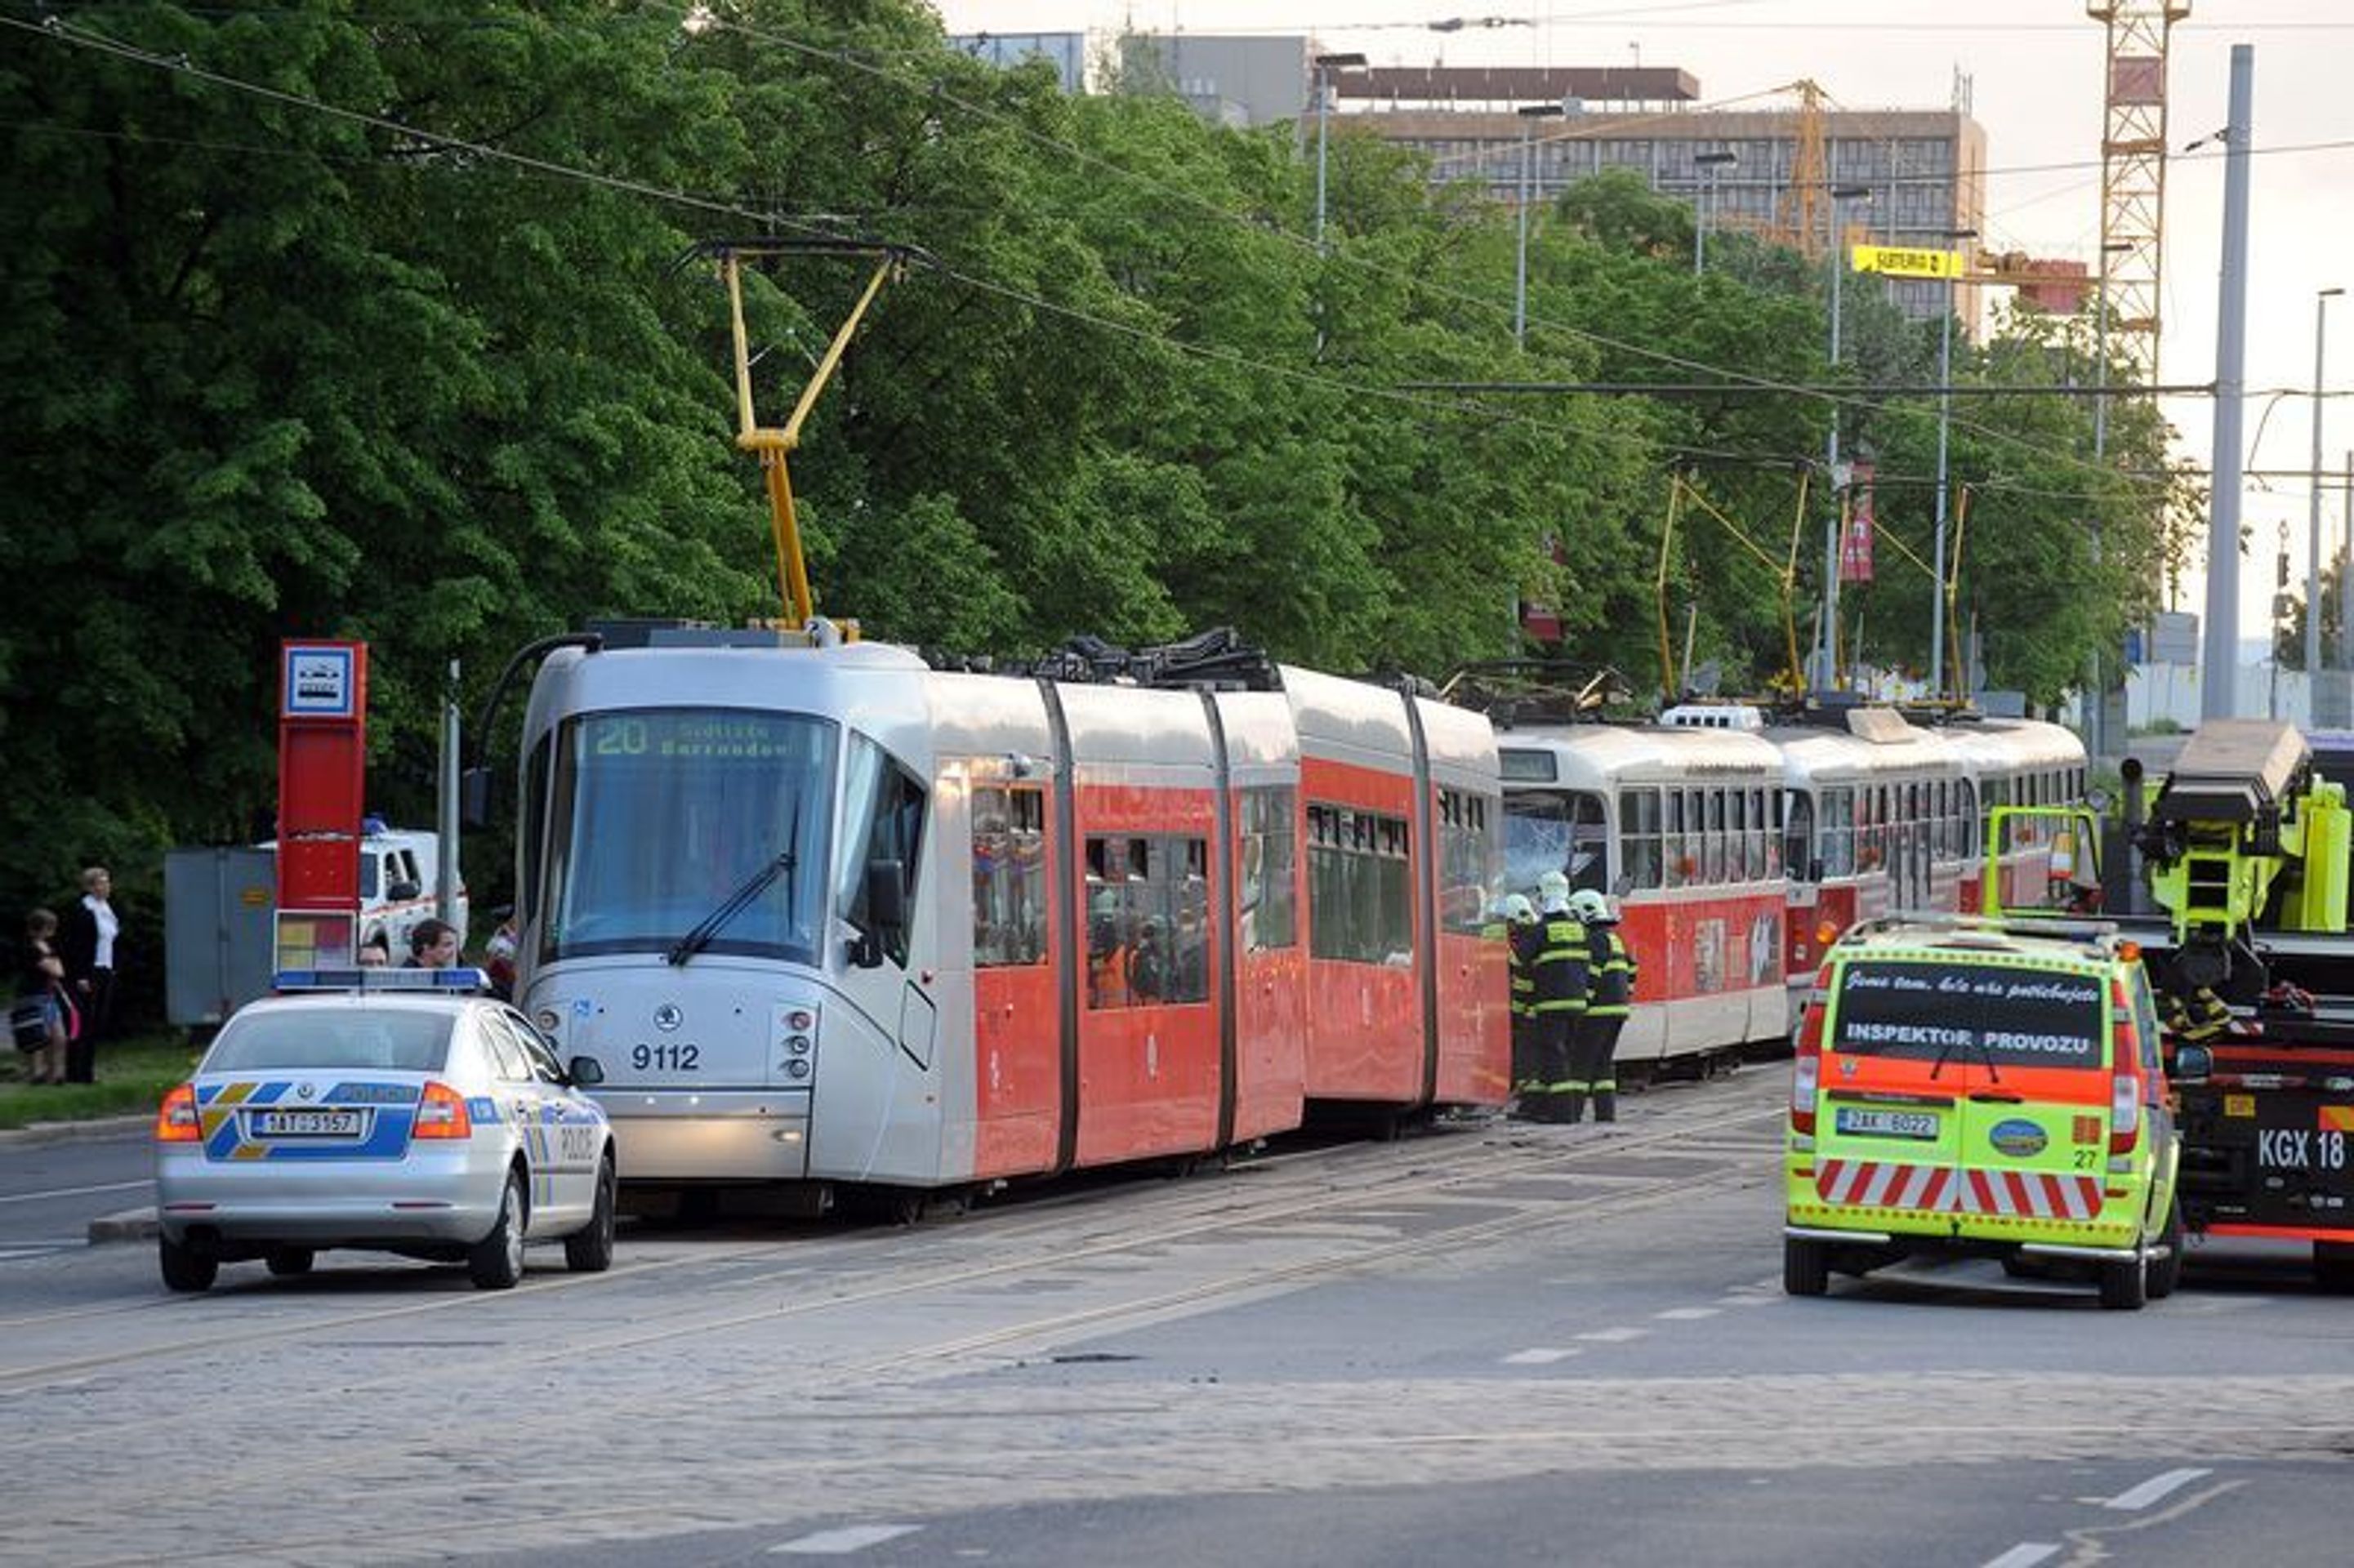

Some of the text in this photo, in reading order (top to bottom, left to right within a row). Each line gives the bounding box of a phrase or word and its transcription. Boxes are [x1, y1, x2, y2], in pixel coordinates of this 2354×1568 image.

[596, 719, 648, 755] 20
[1846, 1022, 2089, 1054] INSPEKTOR PROVOZU
[631, 1045, 700, 1071] 9112
[2073, 1151, 2097, 1169] 27
[2258, 1129, 2345, 1169] KGX 18
